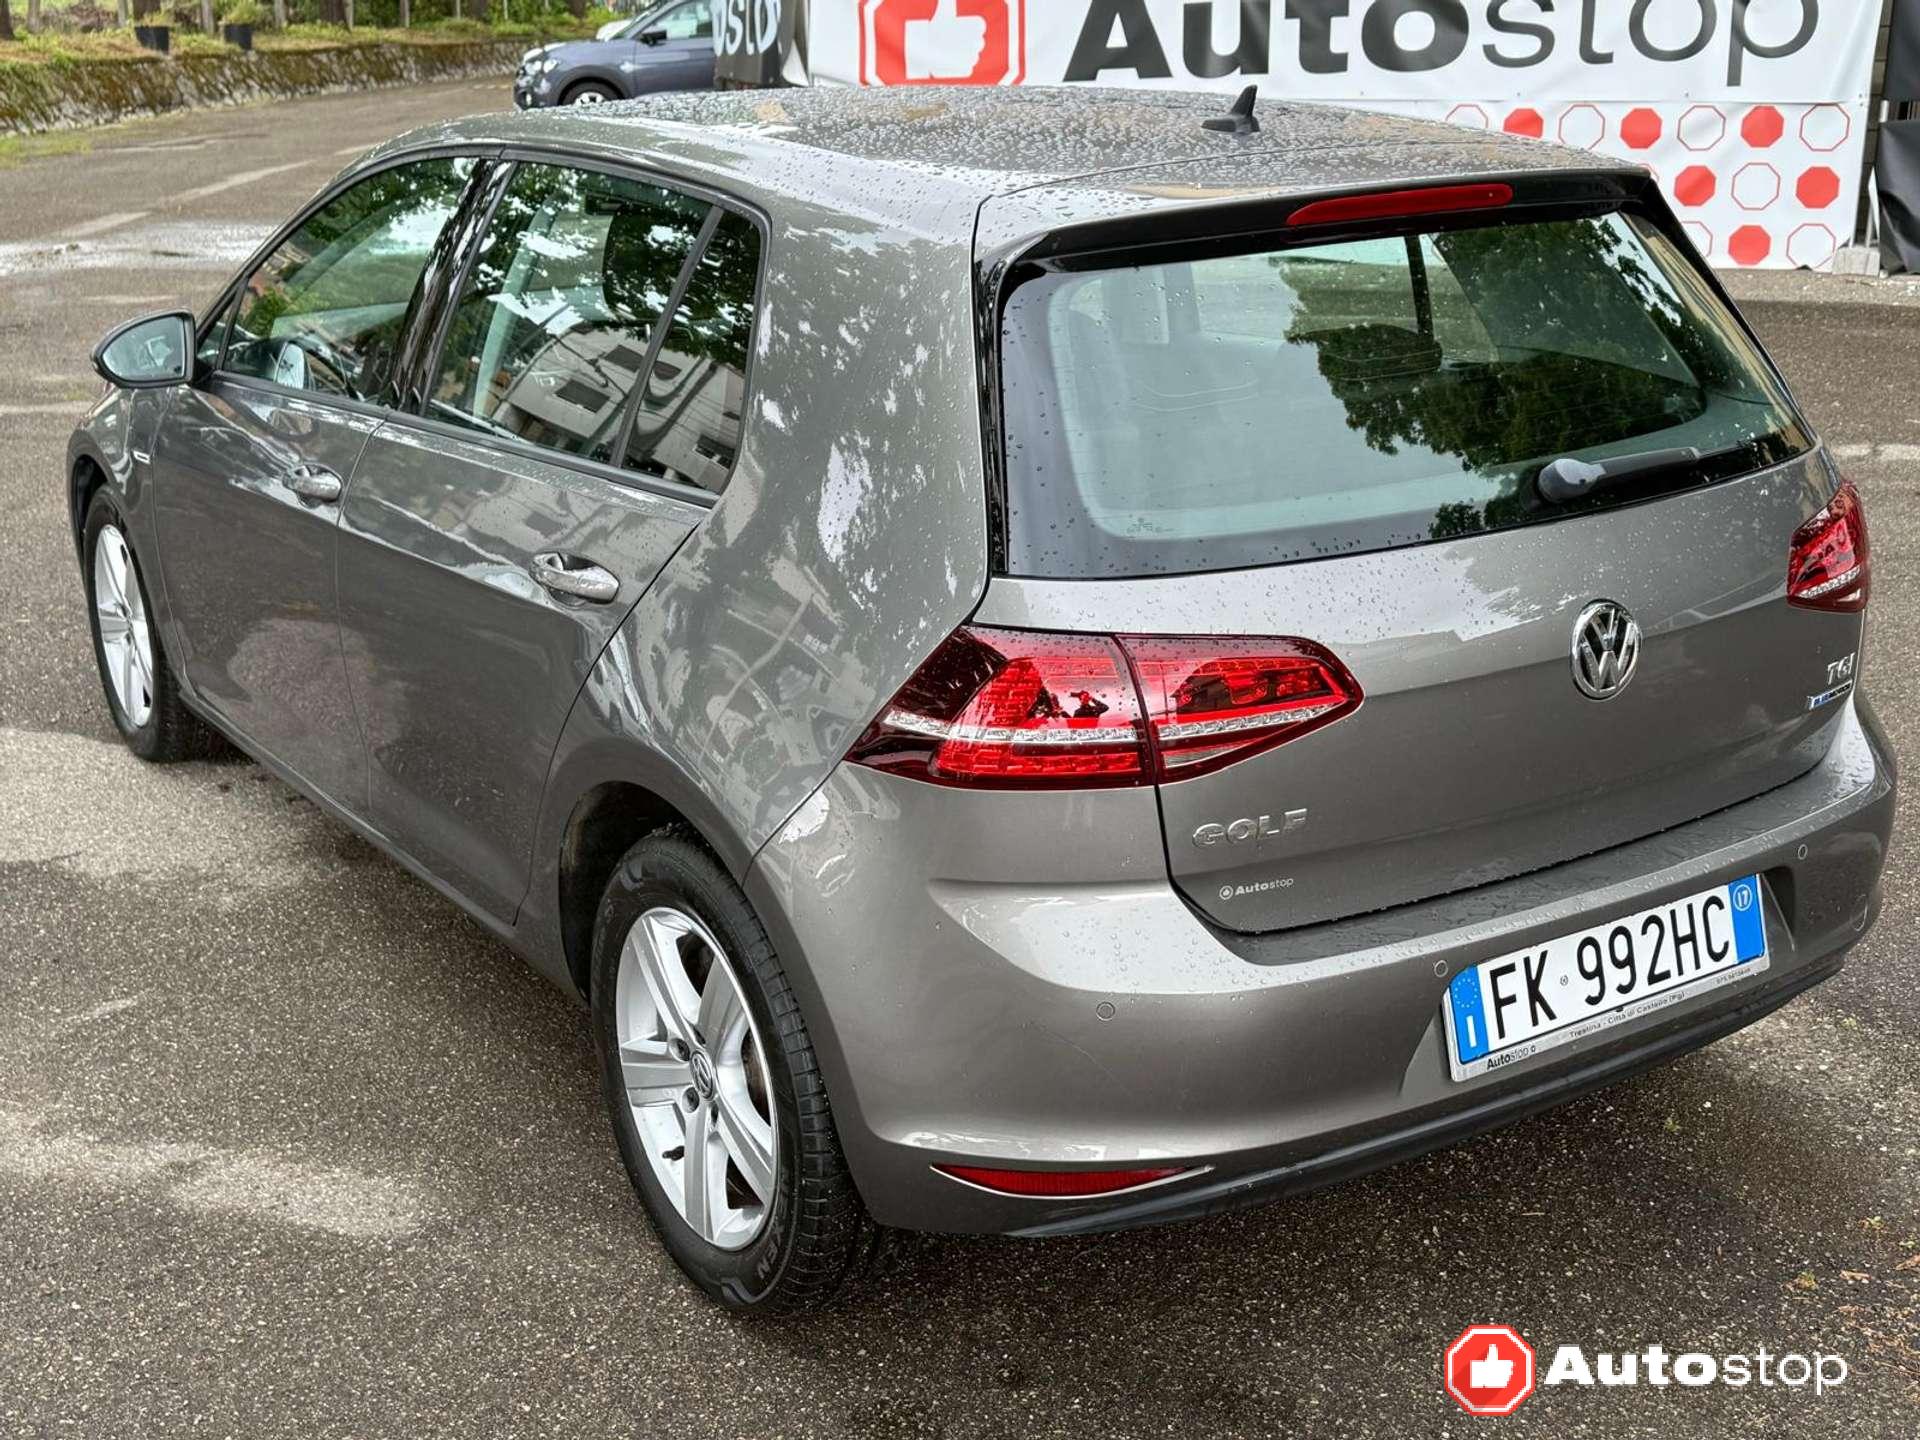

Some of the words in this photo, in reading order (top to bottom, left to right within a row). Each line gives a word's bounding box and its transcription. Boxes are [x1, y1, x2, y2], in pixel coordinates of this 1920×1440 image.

[1062, 0, 1819, 87] Autostop
[1192, 807, 1308, 847] GOLF
[1234, 877, 1295, 896] Autostop
[1737, 889, 1749, 908] 17
[1489, 949, 1558, 1040] FK
[1576, 894, 1730, 1007] 992HC
[1465, 1014, 1478, 1049] I
[1486, 1046, 1530, 1071] Autostop
